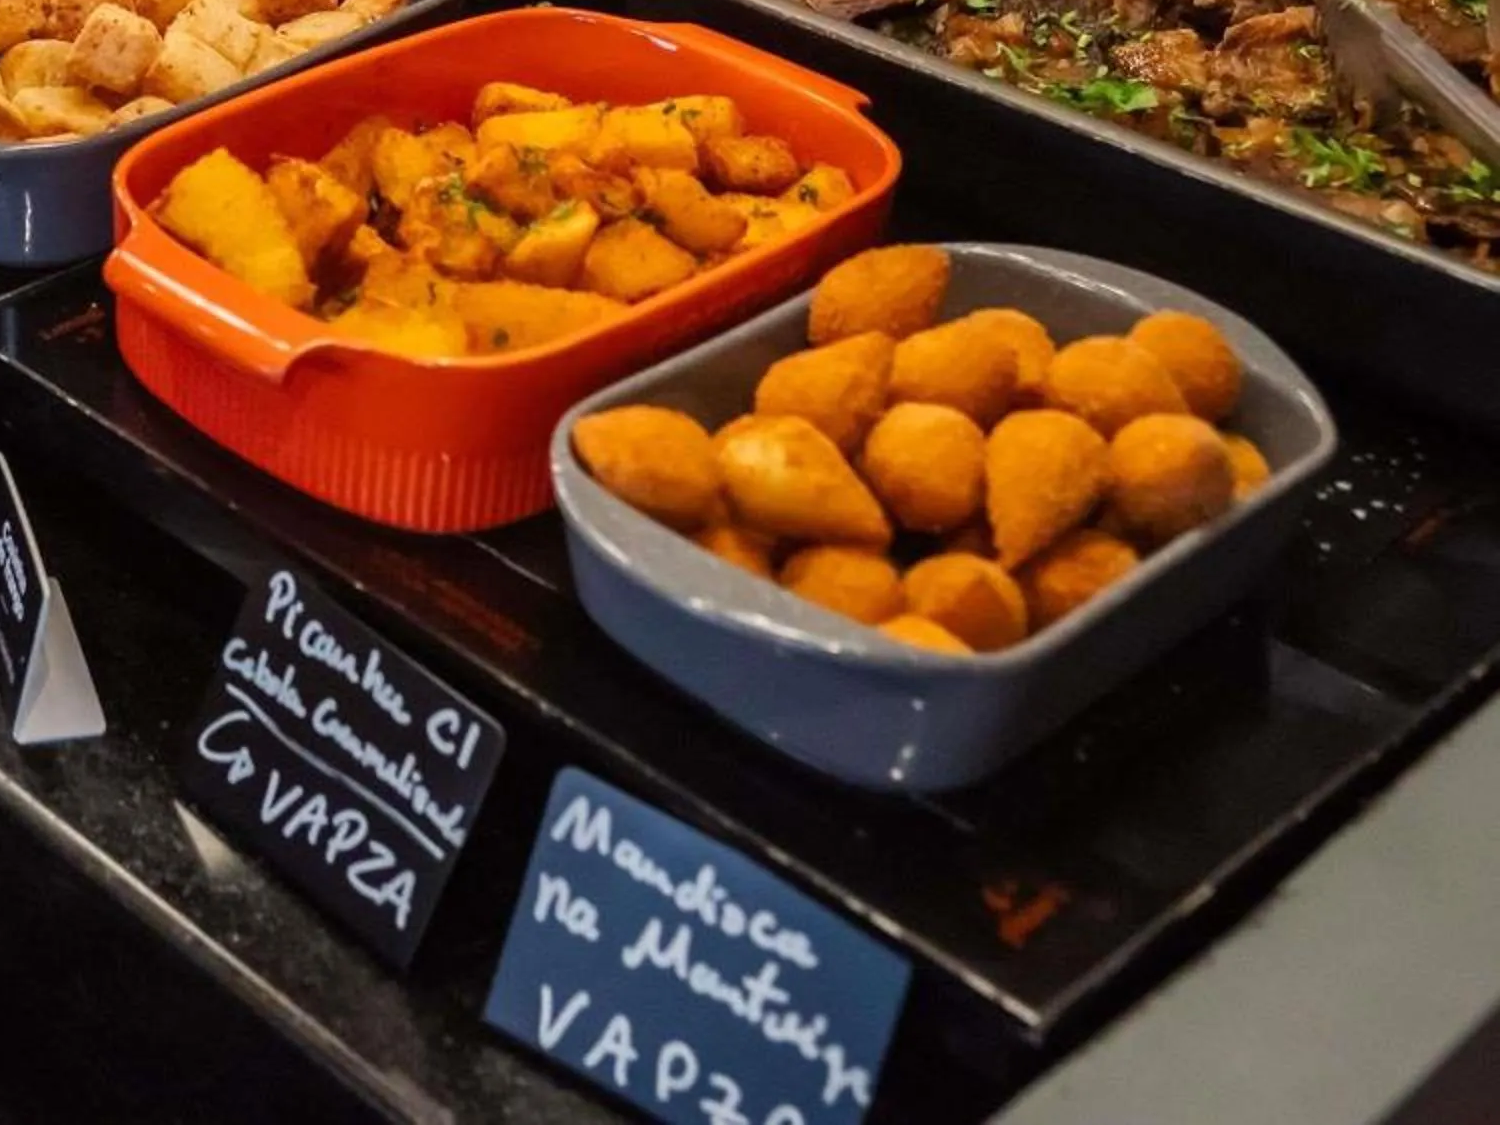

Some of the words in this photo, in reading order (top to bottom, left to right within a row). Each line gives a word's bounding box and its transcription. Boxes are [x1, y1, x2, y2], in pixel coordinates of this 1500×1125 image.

[264, 569, 412, 727] Picanha
[260, 769, 417, 931] VAPZA
[533, 872, 601, 943] na
[550, 795, 819, 969] Mandioca
